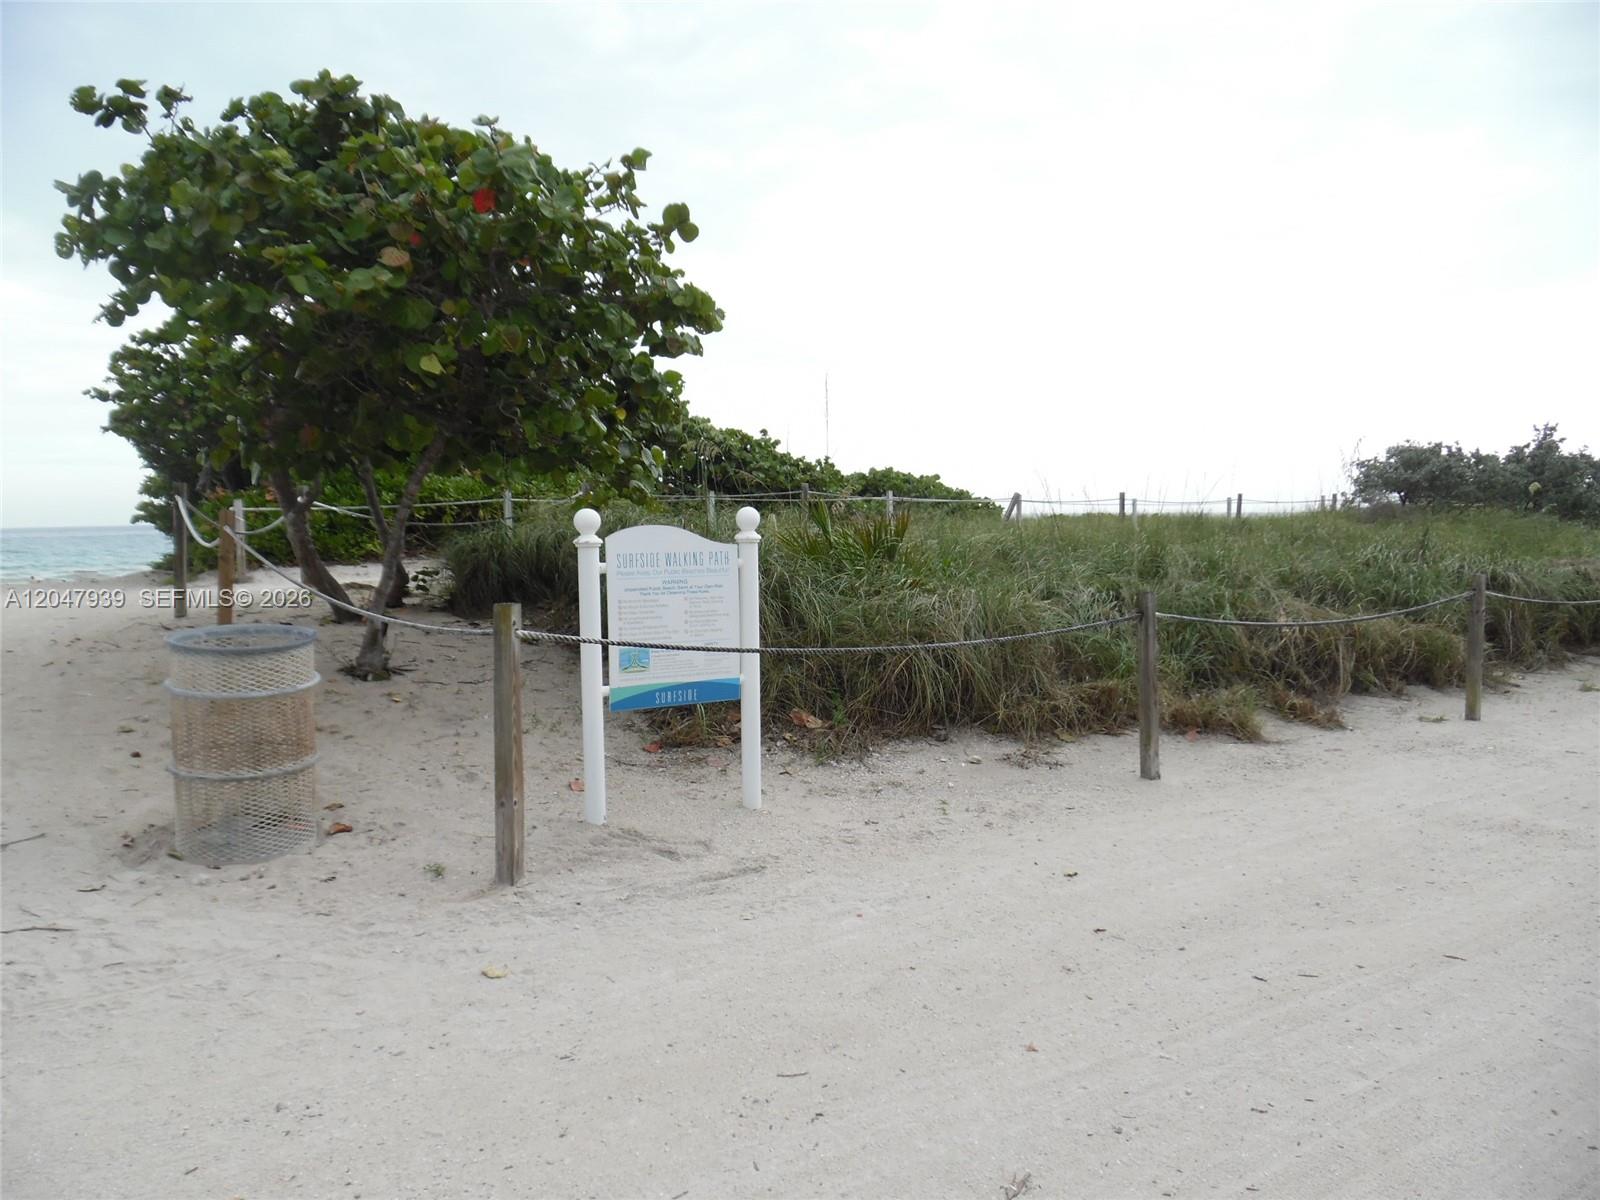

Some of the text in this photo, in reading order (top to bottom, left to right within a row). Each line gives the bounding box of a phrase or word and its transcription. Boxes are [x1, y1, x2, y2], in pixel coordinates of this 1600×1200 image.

[616, 550, 730, 569] SURFSIDE WALKING PATH
[655, 688, 697, 705] SURFSIDE
